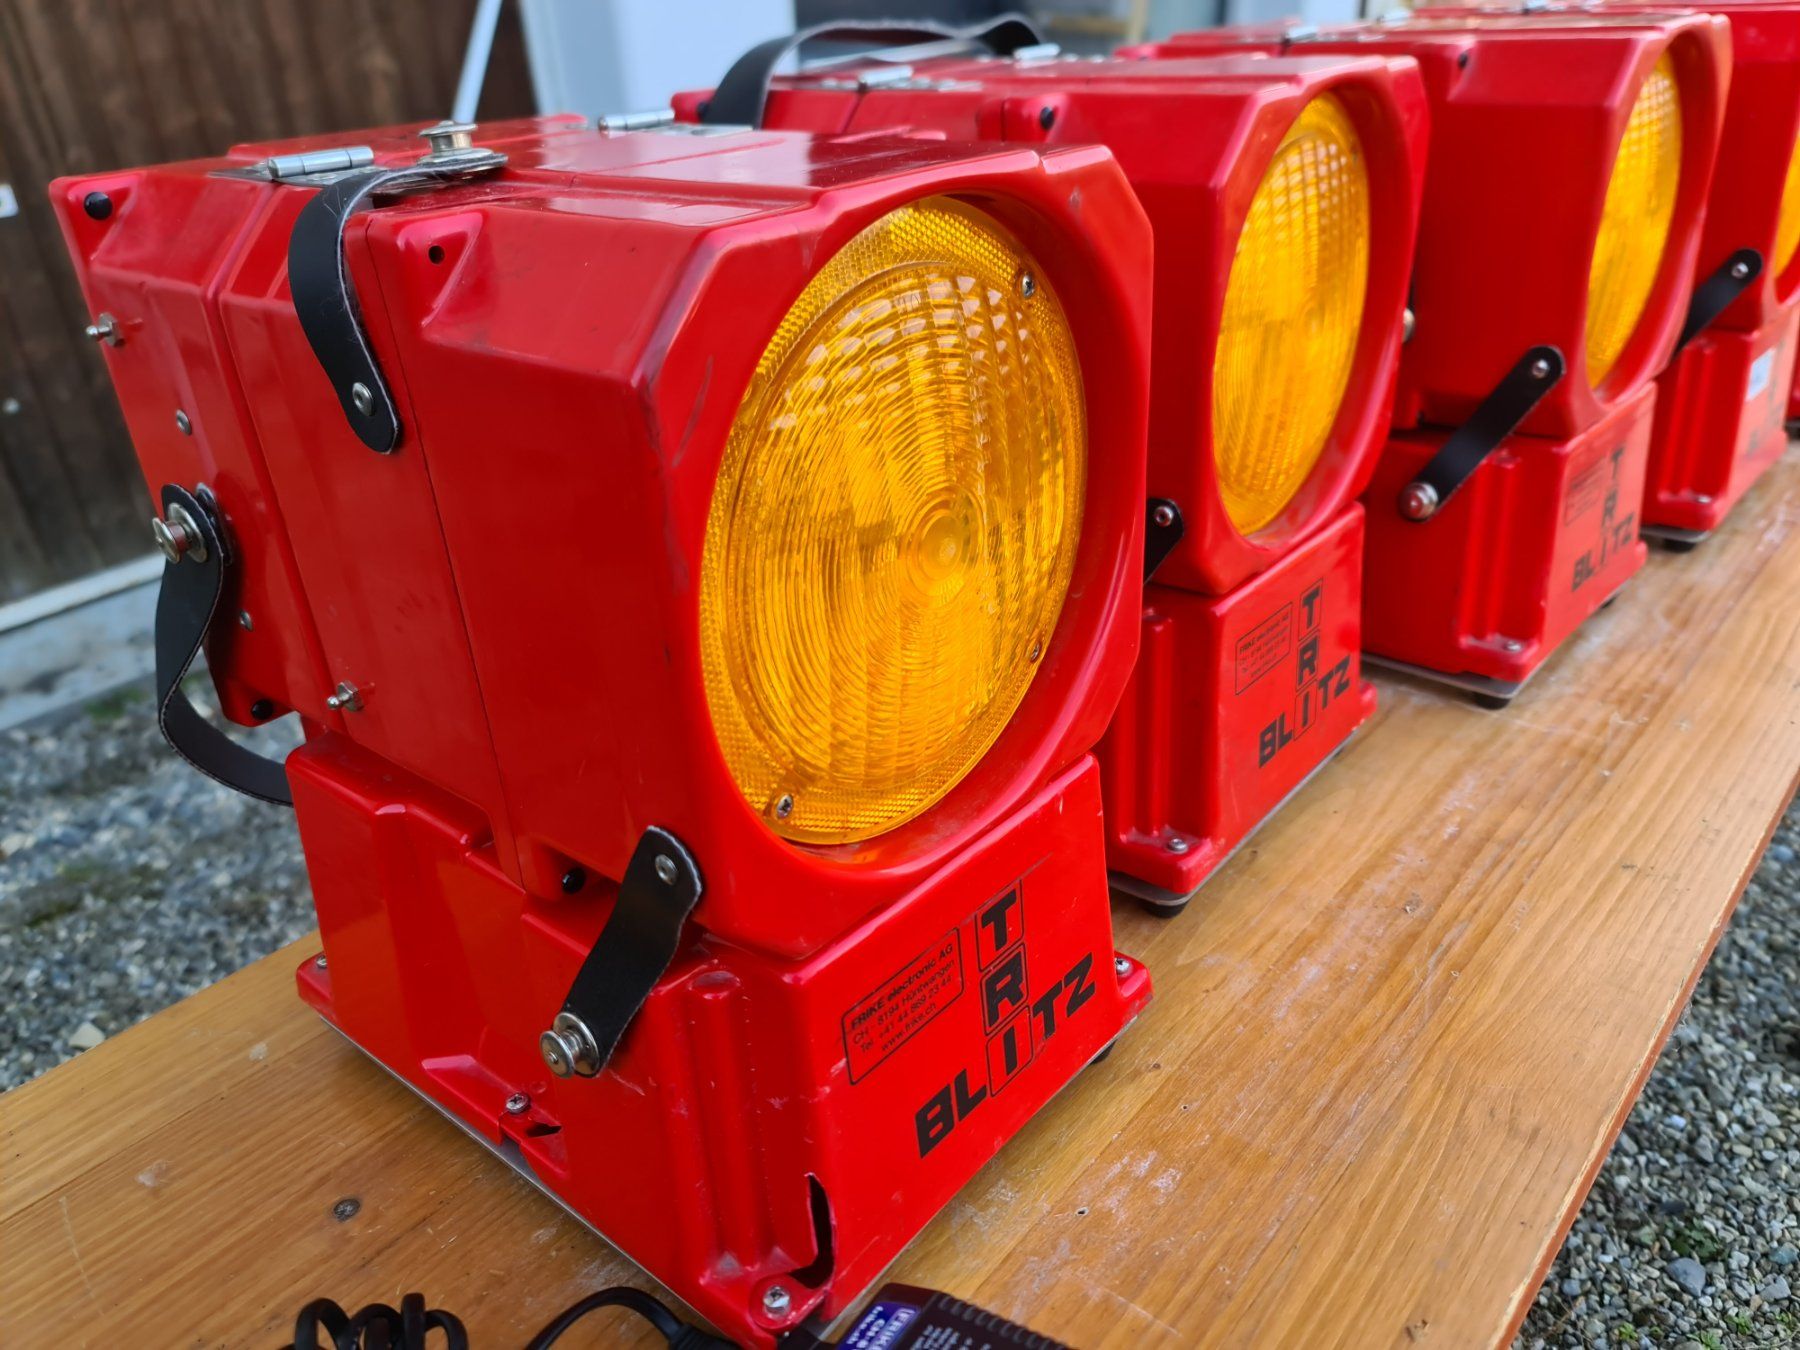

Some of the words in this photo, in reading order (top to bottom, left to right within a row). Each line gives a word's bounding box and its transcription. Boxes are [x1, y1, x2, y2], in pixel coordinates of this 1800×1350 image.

[1259, 655, 1350, 768] BLITZ
[851, 997, 884, 1029] FRIKE
[887, 959, 936, 1001] electronic
[939, 943, 953, 961] AG
[853, 1027, 869, 1045] CH
[915, 952, 1096, 1159] BLITZ
